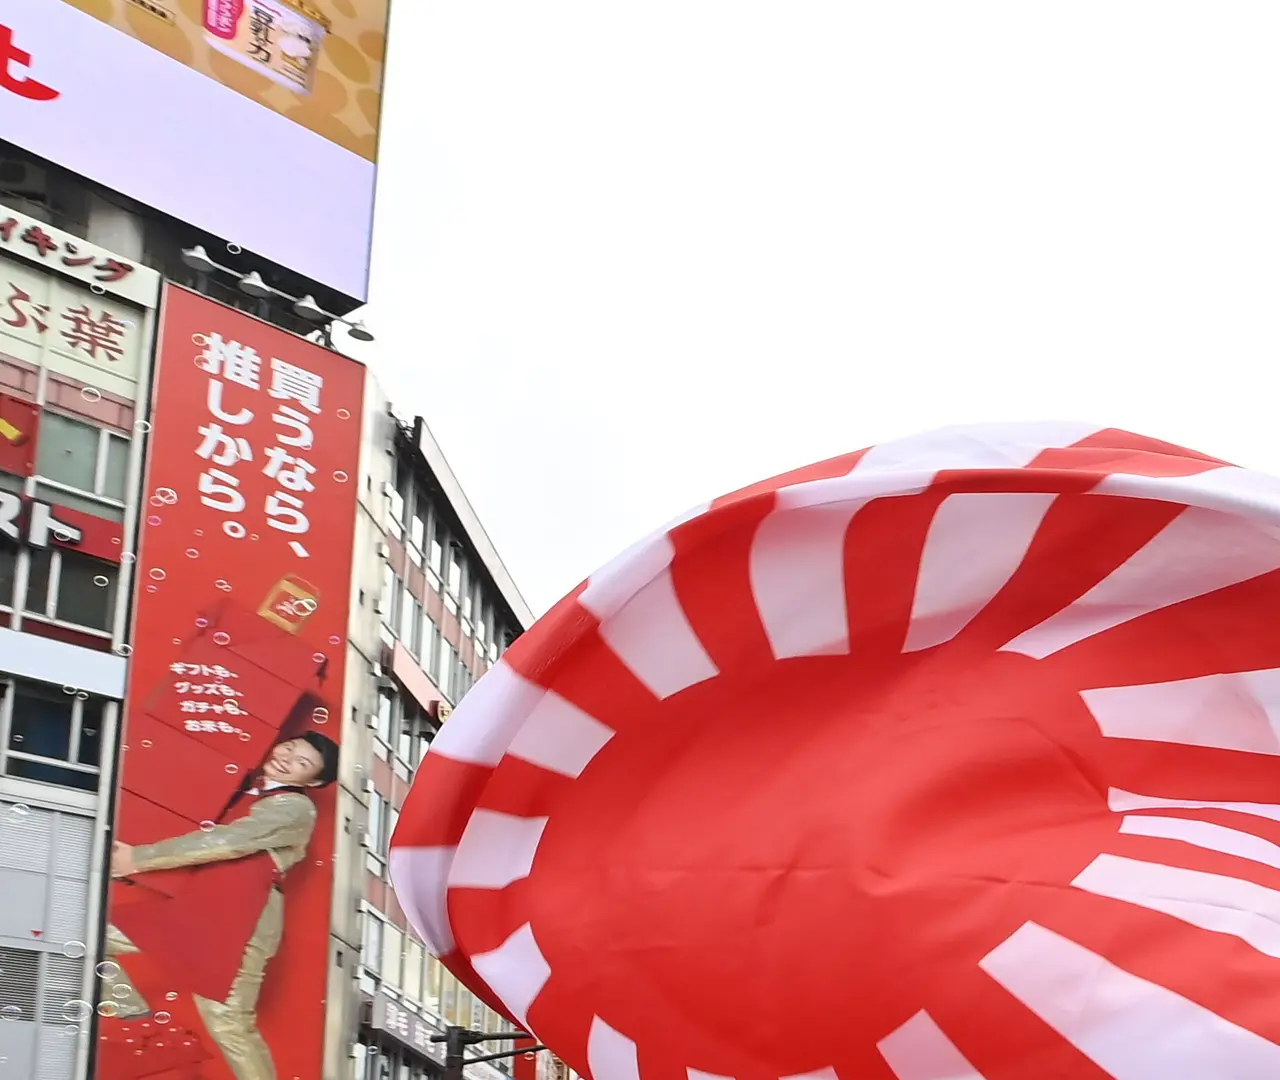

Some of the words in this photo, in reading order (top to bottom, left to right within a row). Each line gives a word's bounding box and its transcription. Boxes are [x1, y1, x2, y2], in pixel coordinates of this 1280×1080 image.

[196, 332, 261, 539] 推しから。
[264, 356, 324, 558] 買うなら、
[170, 661, 239, 680] ギフトも、
[175, 680, 244, 699] グッズも、
